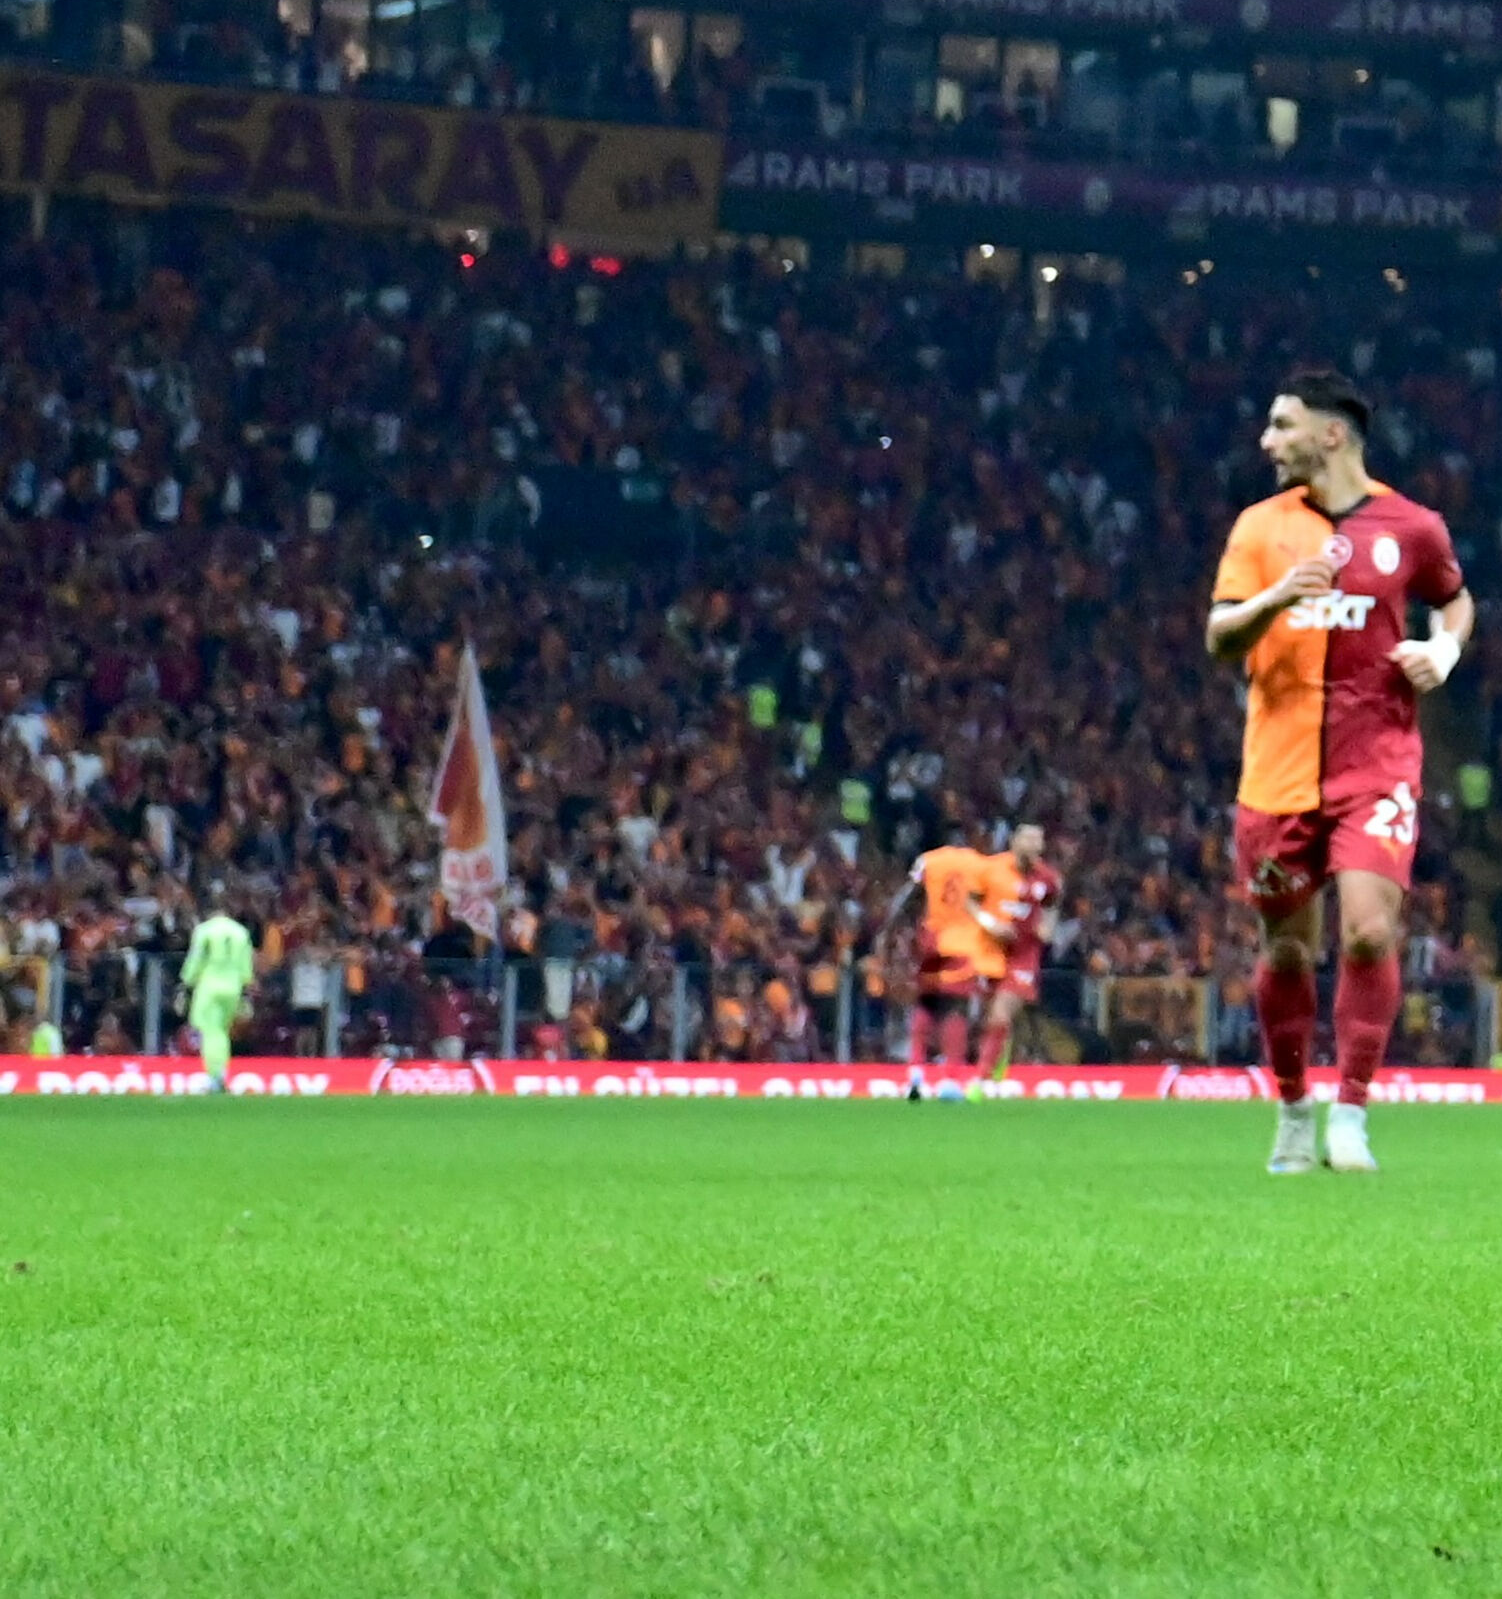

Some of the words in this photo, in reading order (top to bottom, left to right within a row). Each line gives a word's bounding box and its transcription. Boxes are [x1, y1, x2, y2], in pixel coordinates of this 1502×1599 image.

[763, 152, 889, 197] RAMS
[904, 162, 1023, 205] PARK
[1209, 184, 1338, 223] RAMS
[1353, 188, 1470, 226] PARK
[1286, 588, 1376, 632] SIXT
